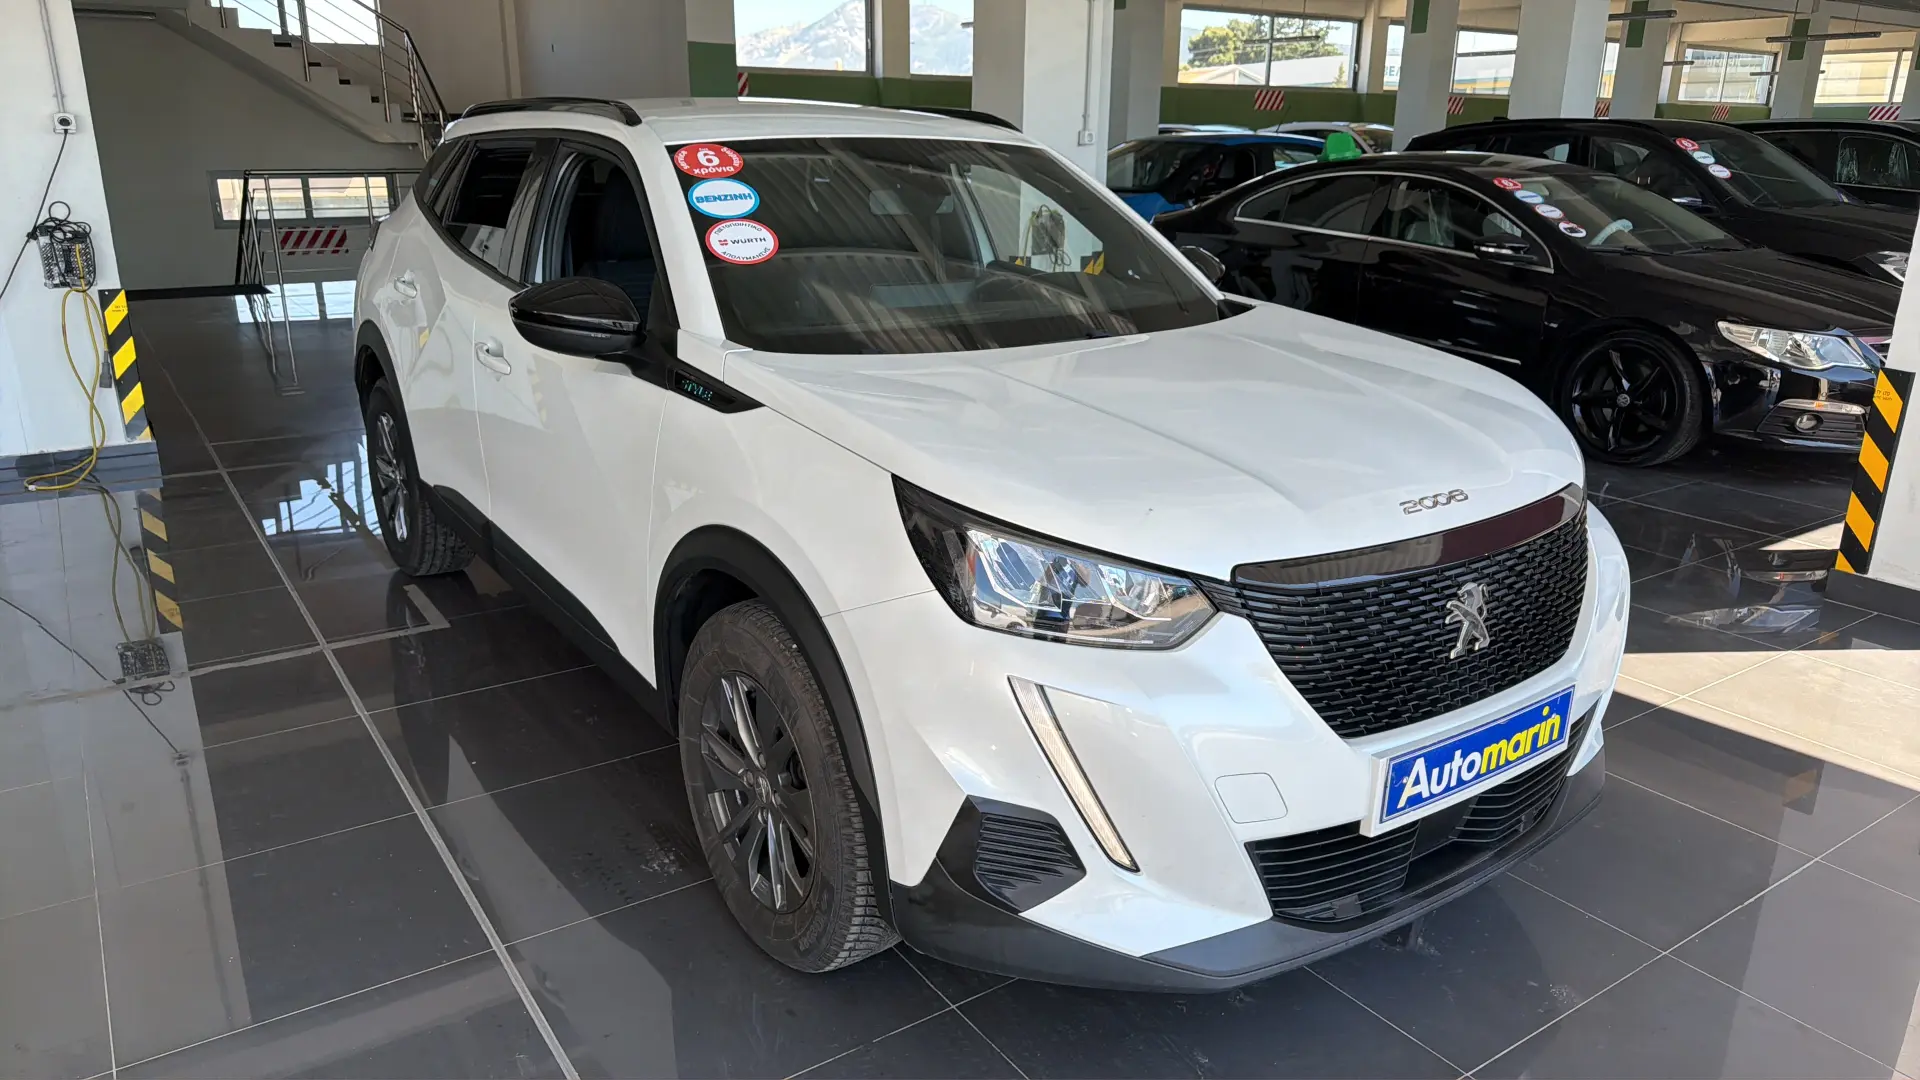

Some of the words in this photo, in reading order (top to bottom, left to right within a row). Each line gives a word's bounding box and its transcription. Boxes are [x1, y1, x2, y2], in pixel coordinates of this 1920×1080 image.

[697, 150, 720, 167] 6
[693, 166, 735, 175] χρόνια
[1399, 489, 1469, 515] 2008
[1397, 705, 1561, 809] Automarin
